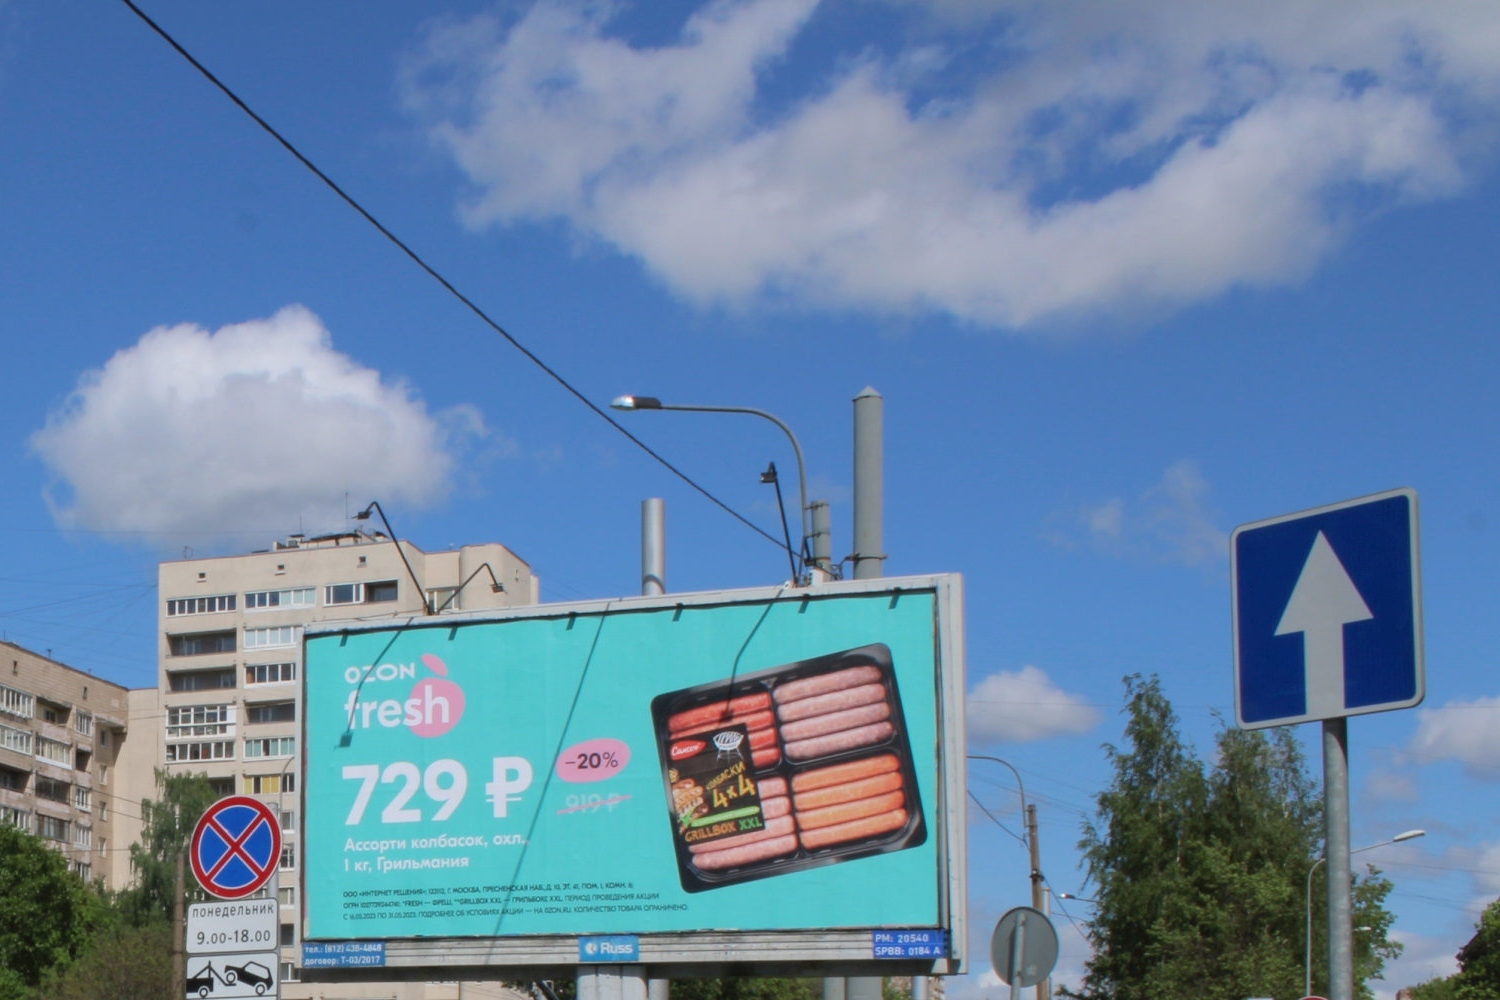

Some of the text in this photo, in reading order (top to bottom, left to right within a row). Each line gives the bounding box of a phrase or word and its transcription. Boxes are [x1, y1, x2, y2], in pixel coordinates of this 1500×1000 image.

[344, 662, 416, 684] OZON
[344, 684, 450, 730] fresh
[342, 758, 469, 826] 729
[685, 816, 763, 842] GRILLBOX XXL
[344, 837, 407, 854] Ассорти
[411, 833, 489, 849] колбасок,
[354, 859, 373, 874] кг,
[376, 856, 470, 874] Грильмания
[343, 890, 358, 898] ООО
[564, 894, 591, 902] ПЕРИОД
[592, 893, 635, 901] ПРОВЕДЕНИЯ
[636, 892, 660, 900] АКЦИИ
[192, 904, 274, 918] понедельник
[573, 904, 617, 913] КОЛИЧЕСТВО
[617, 904, 643, 912] ТОВАРА
[197, 929, 271, 946] 9.00-18.00
[897, 933, 930, 944] 20540
[601, 942, 634, 954] Russ
[908, 946, 931, 956] 0184
